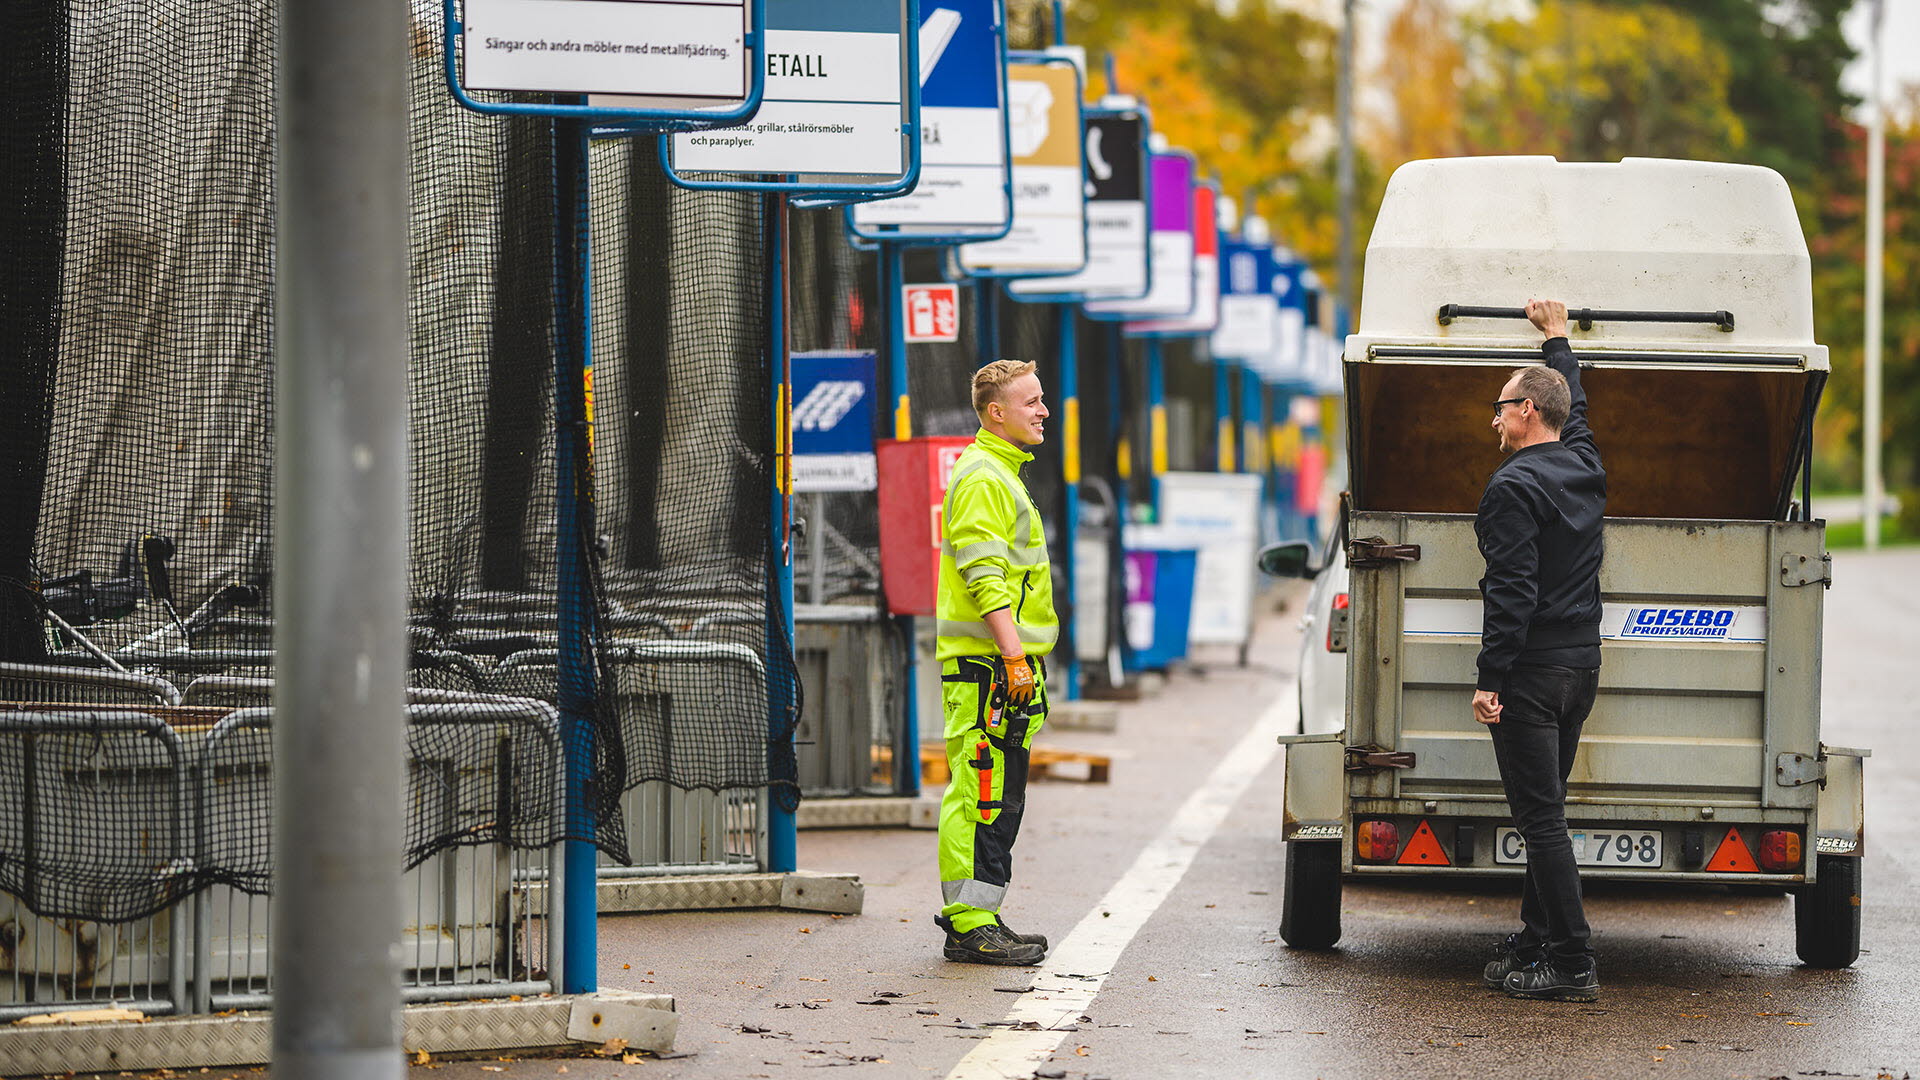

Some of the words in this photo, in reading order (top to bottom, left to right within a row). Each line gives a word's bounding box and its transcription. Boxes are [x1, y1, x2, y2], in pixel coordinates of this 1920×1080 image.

[486, 37, 524, 53] Sängar
[527, 38, 547, 51] och
[550, 40, 581, 52] andra
[583, 40, 622, 54] möbler
[624, 42, 648, 54] med
[651, 43, 730, 60] metallfjädring.
[767, 53, 828, 77] ETALL
[757, 122, 787, 134] grillar,
[788, 122, 854, 134] stålrörsmöbler
[690, 135, 708, 146] och
[709, 136, 755, 148] paraplyer.
[1636, 608, 1734, 627] GISEBO
[1631, 626, 1728, 637] PROFFSVAGNEN
[1593, 833, 1656, 863] 798
